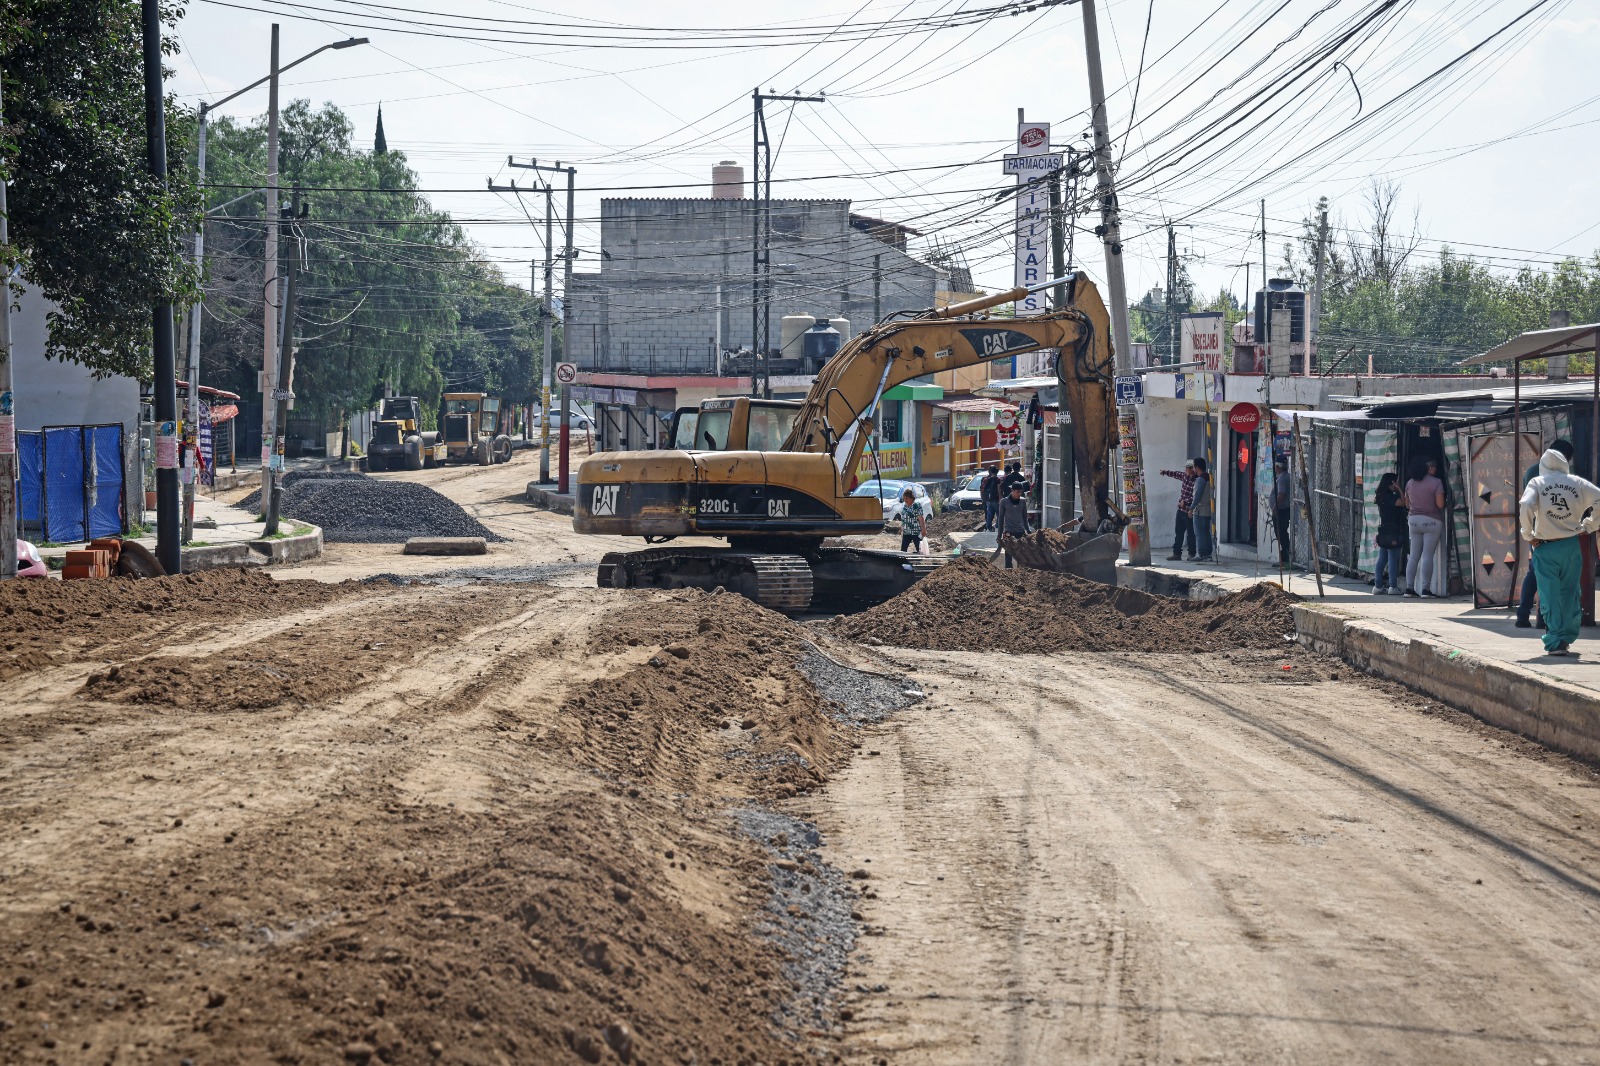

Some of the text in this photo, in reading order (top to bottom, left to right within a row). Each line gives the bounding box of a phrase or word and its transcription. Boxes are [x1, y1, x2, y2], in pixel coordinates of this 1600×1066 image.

[1008, 158, 1059, 170] FARMACIAS
[983, 331, 1008, 355] CAT
[1554, 483, 1579, 499] Angeles
[591, 485, 620, 516] CAT
[700, 499, 730, 513] 320C
[768, 499, 791, 518] CAT
[1550, 493, 1570, 511] LA
